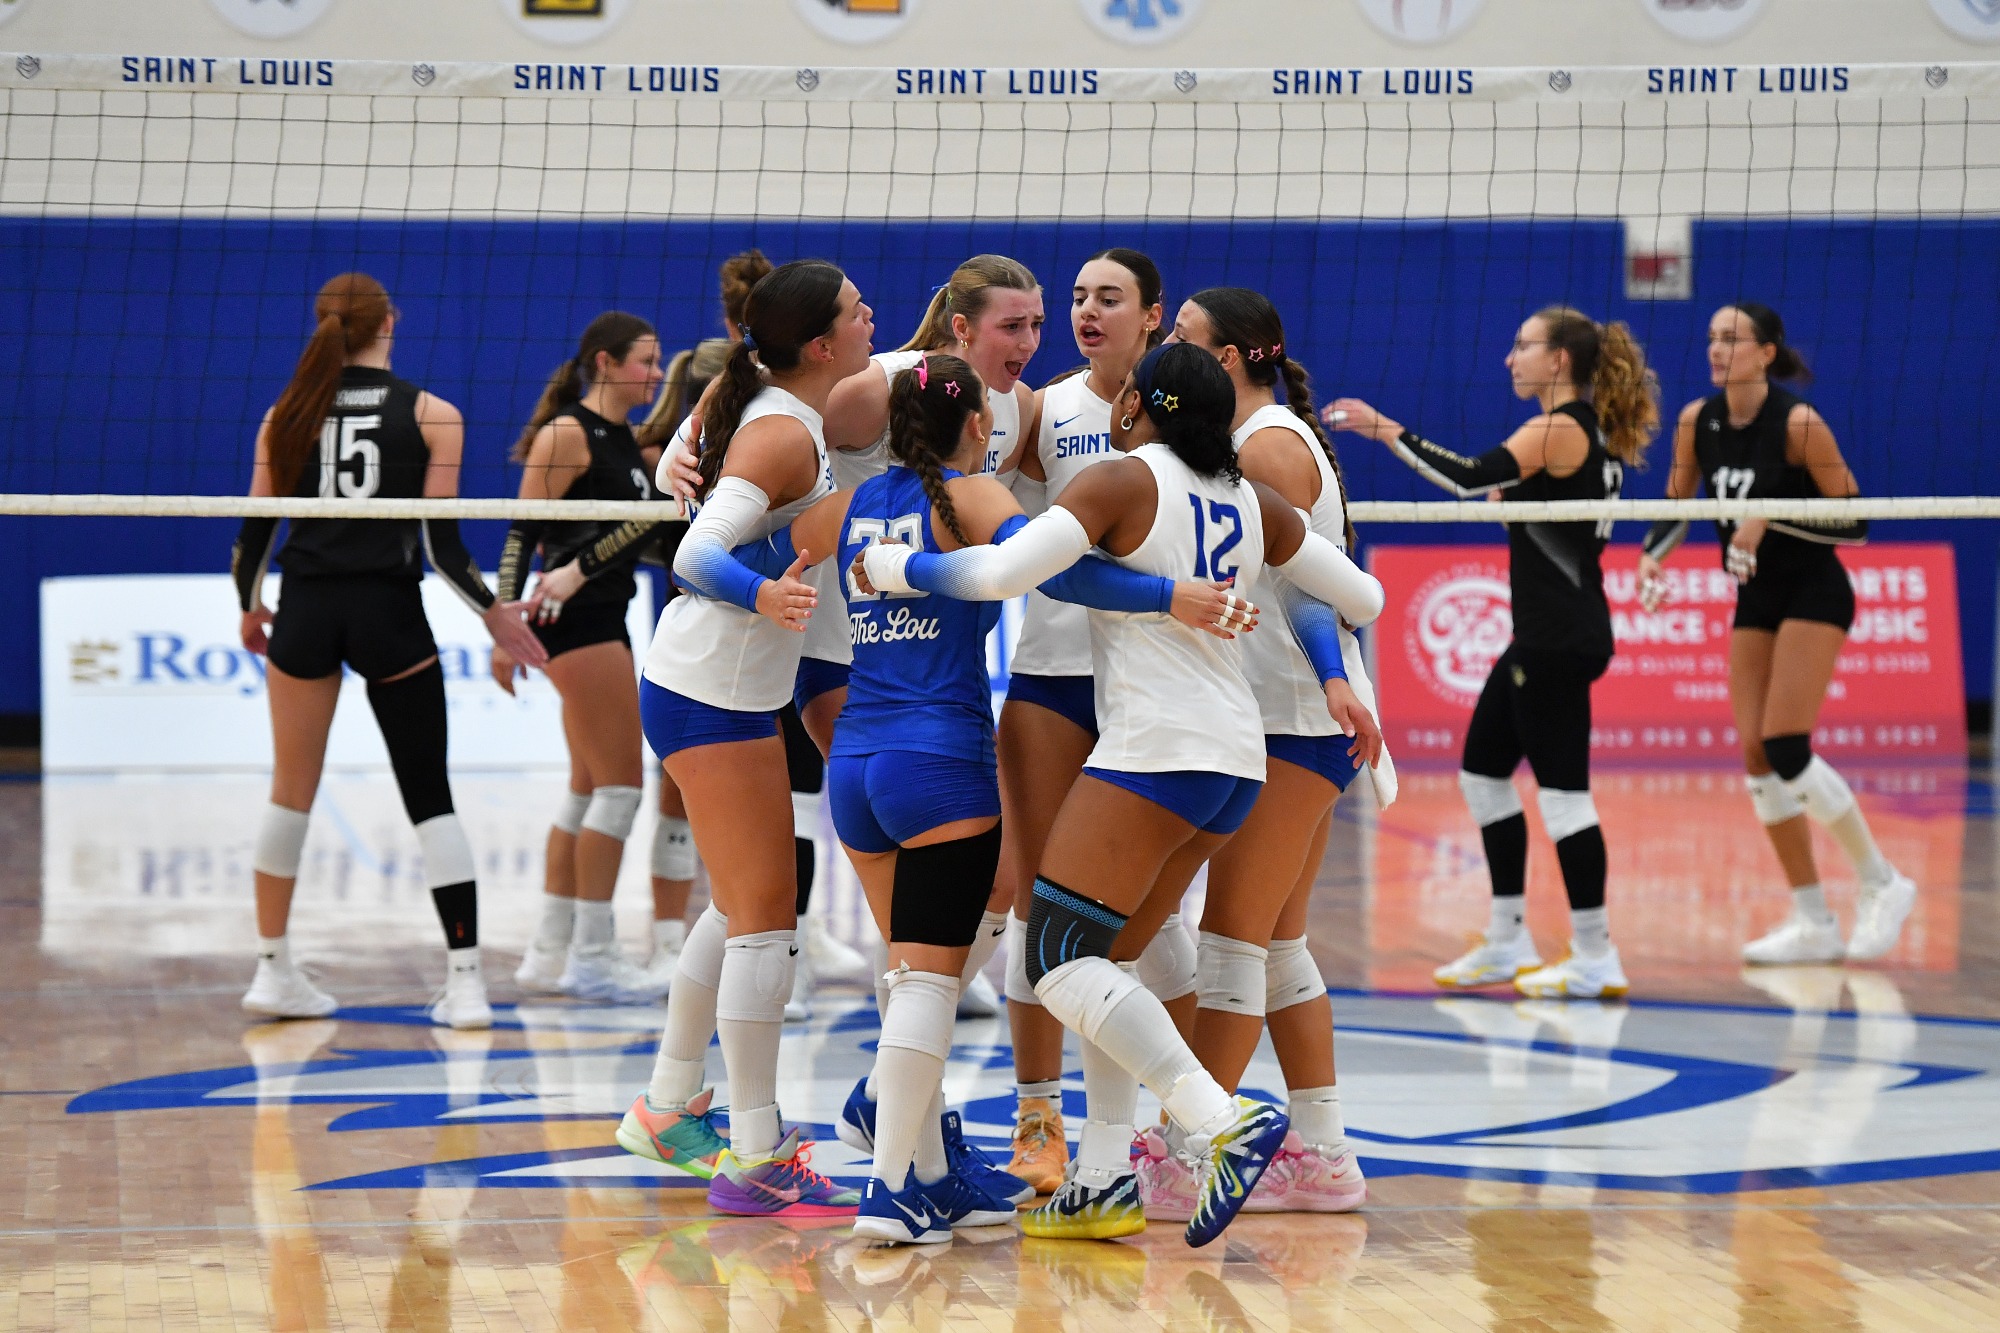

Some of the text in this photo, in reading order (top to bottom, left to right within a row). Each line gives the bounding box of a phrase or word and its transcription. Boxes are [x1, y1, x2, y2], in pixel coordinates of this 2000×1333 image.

[122, 56, 334, 86] SAINT LOUIS
[514, 64, 720, 92] SAINT LOUIS
[897, 68, 1099, 95] SAINT LOUIS
[1273, 69, 1474, 95] SAINT LOUIS
[1648, 66, 1849, 93] SAINT LOUIS
[318, 415, 382, 498] 15
[1056, 432, 1111, 459] SAINT
[1711, 465, 1756, 528] 17
[1187, 491, 1243, 589] 12
[850, 606, 941, 645] The Lou
[1611, 606, 1929, 645] ANCE USIC
